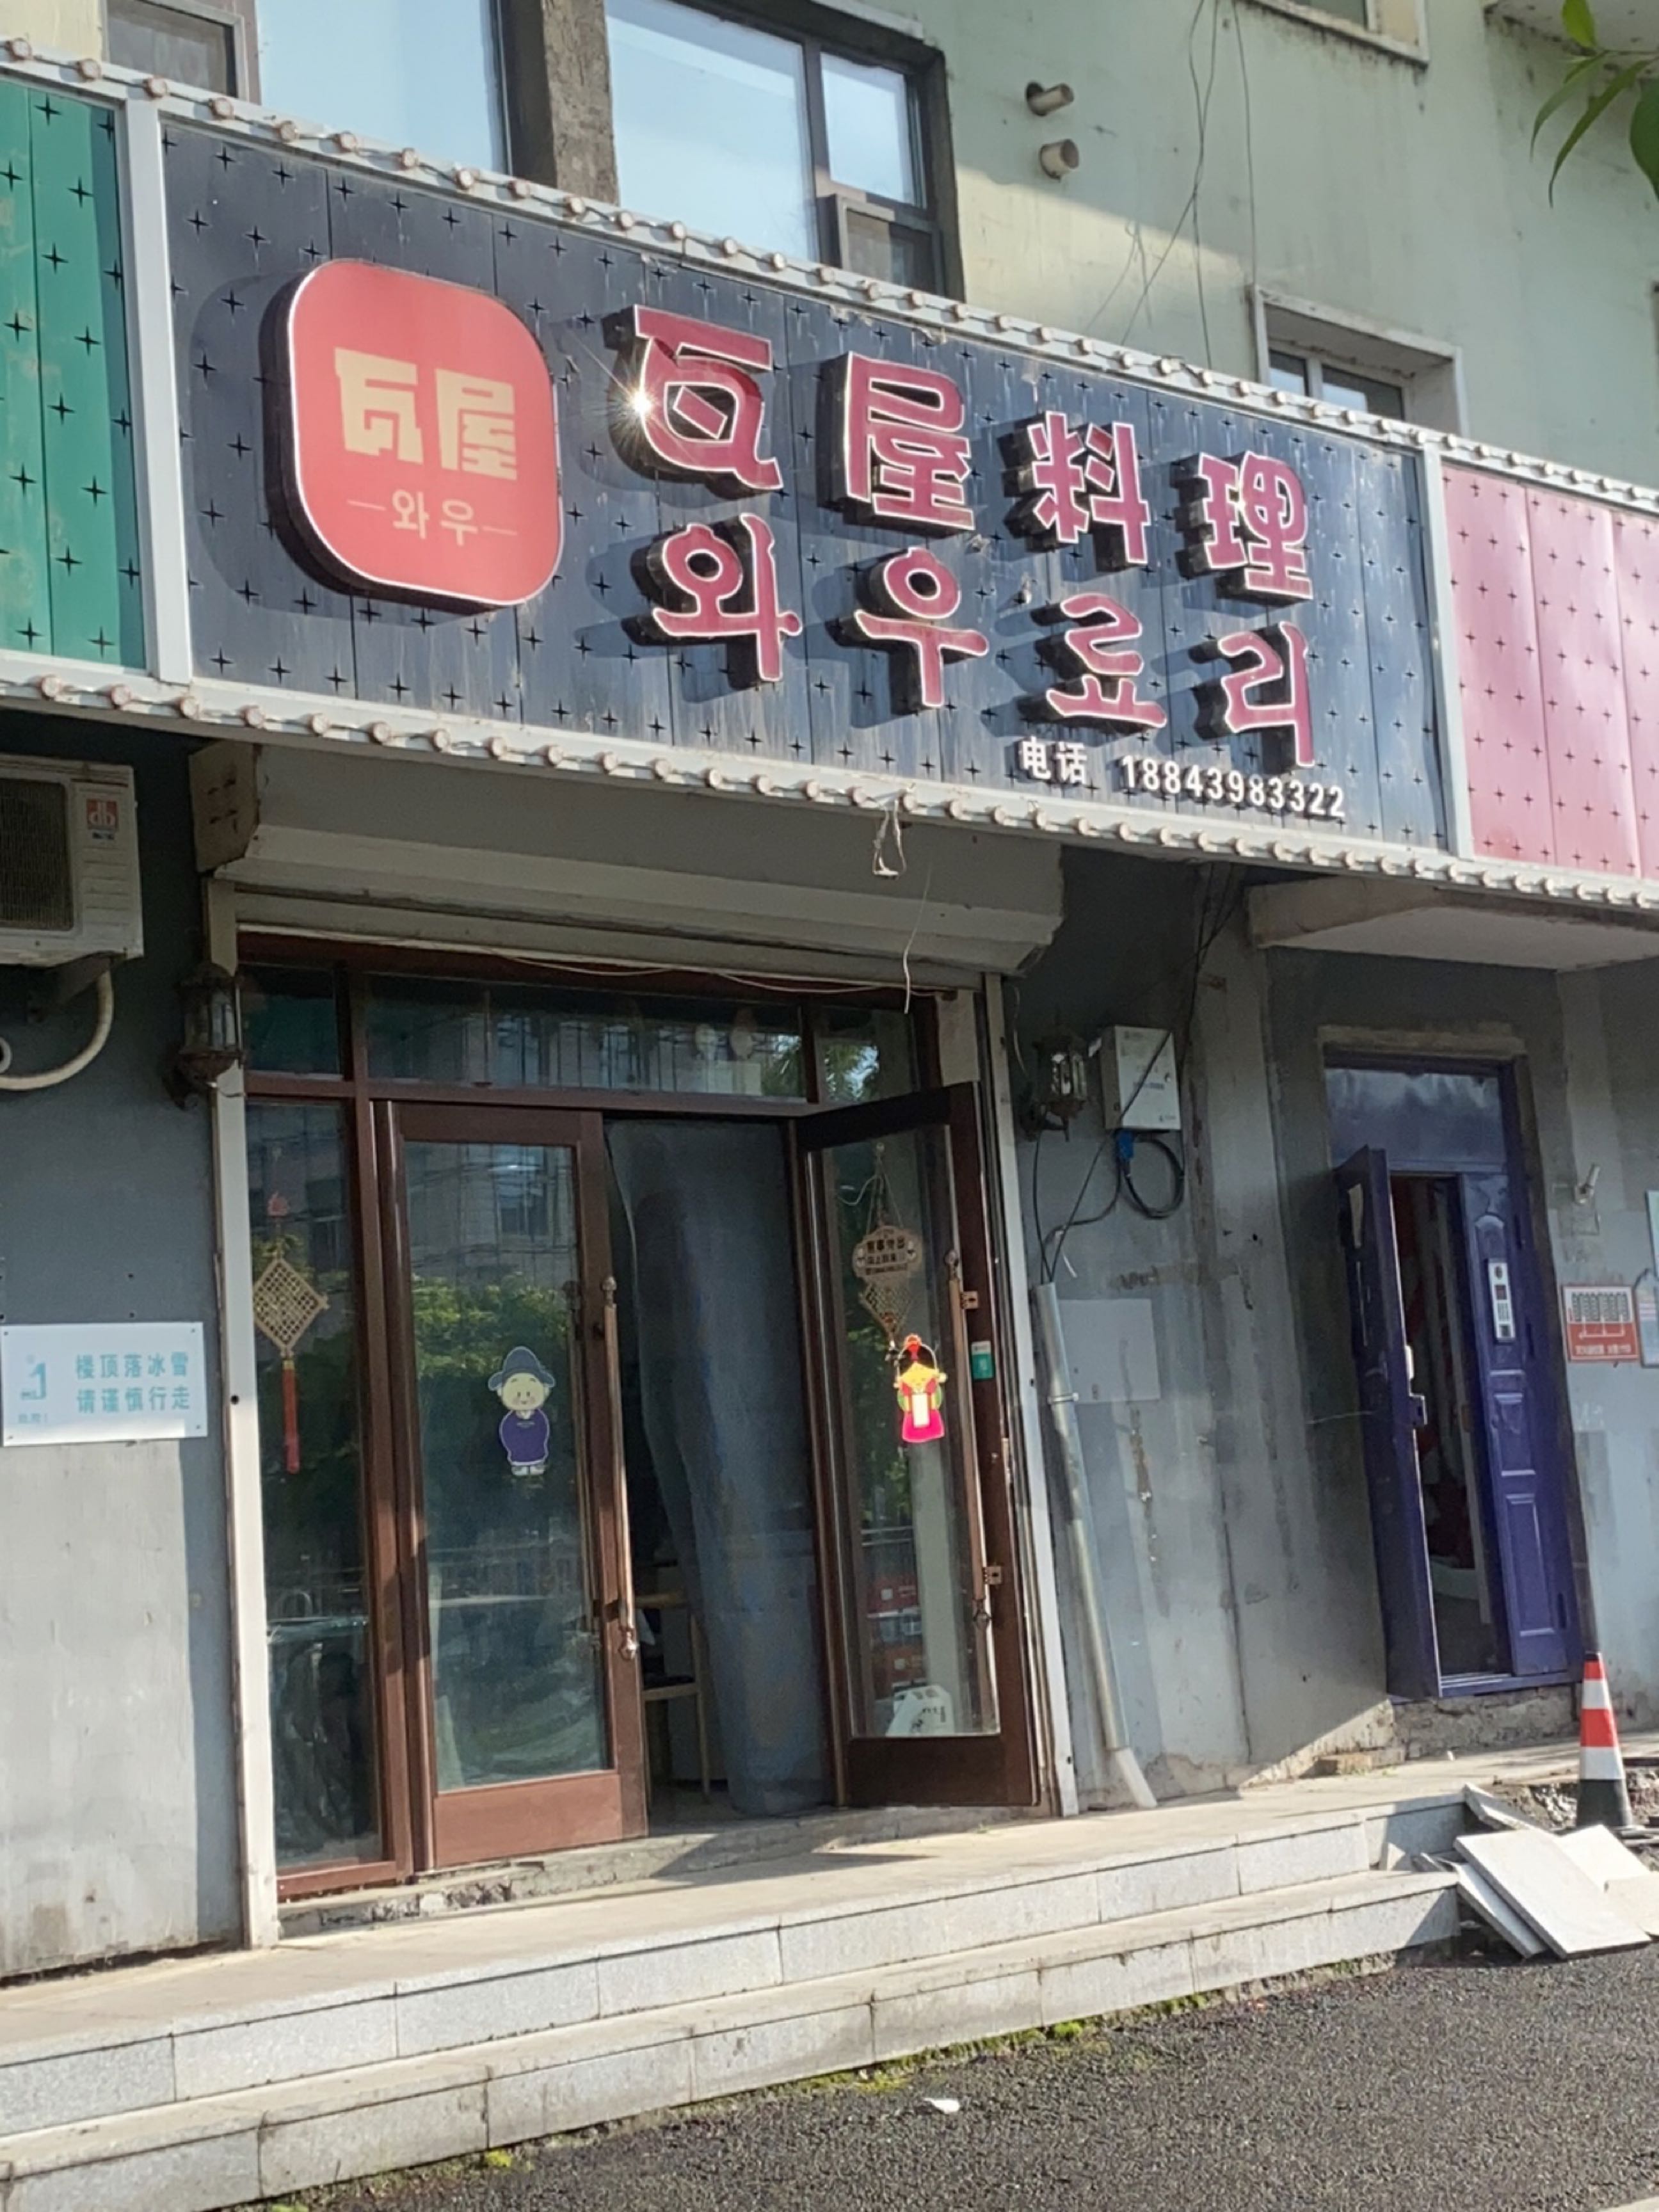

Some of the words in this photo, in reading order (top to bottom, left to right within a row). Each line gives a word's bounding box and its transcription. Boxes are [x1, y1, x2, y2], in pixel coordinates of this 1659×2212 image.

[333, 346, 518, 481] 瓦屋
[632, 303, 1314, 600] 瓦屋料理
[392, 489, 479, 547] 와우
[1020, 735, 1088, 785] 电话
[1120, 754, 1346, 818] 18843983322
[75, 1351, 189, 1379] 楼顶落冰雪
[76, 1386, 191, 1414] 请谨慎行走
